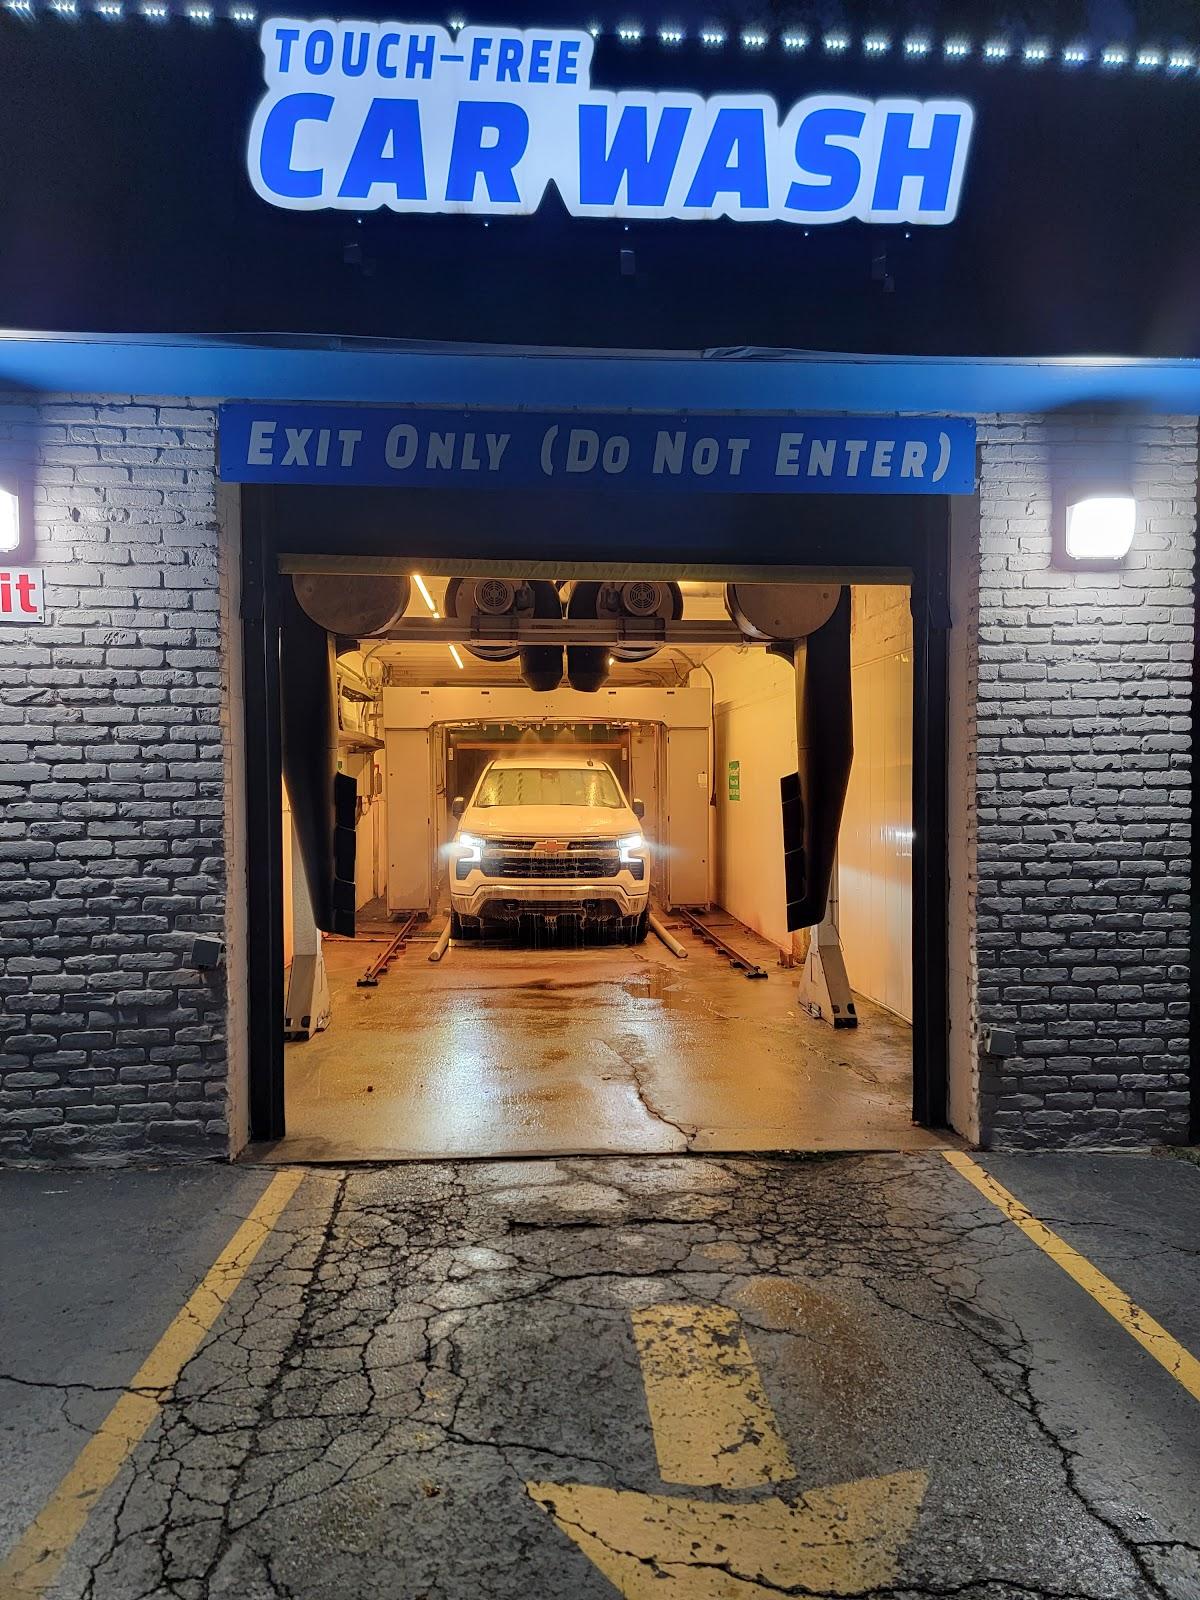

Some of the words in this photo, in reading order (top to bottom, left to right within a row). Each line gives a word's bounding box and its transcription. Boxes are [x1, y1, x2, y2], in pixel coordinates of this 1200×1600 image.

[275, 28, 582, 85] TOUCH-FREE
[258, 92, 530, 203] CAR
[577, 103, 963, 213] WASH
